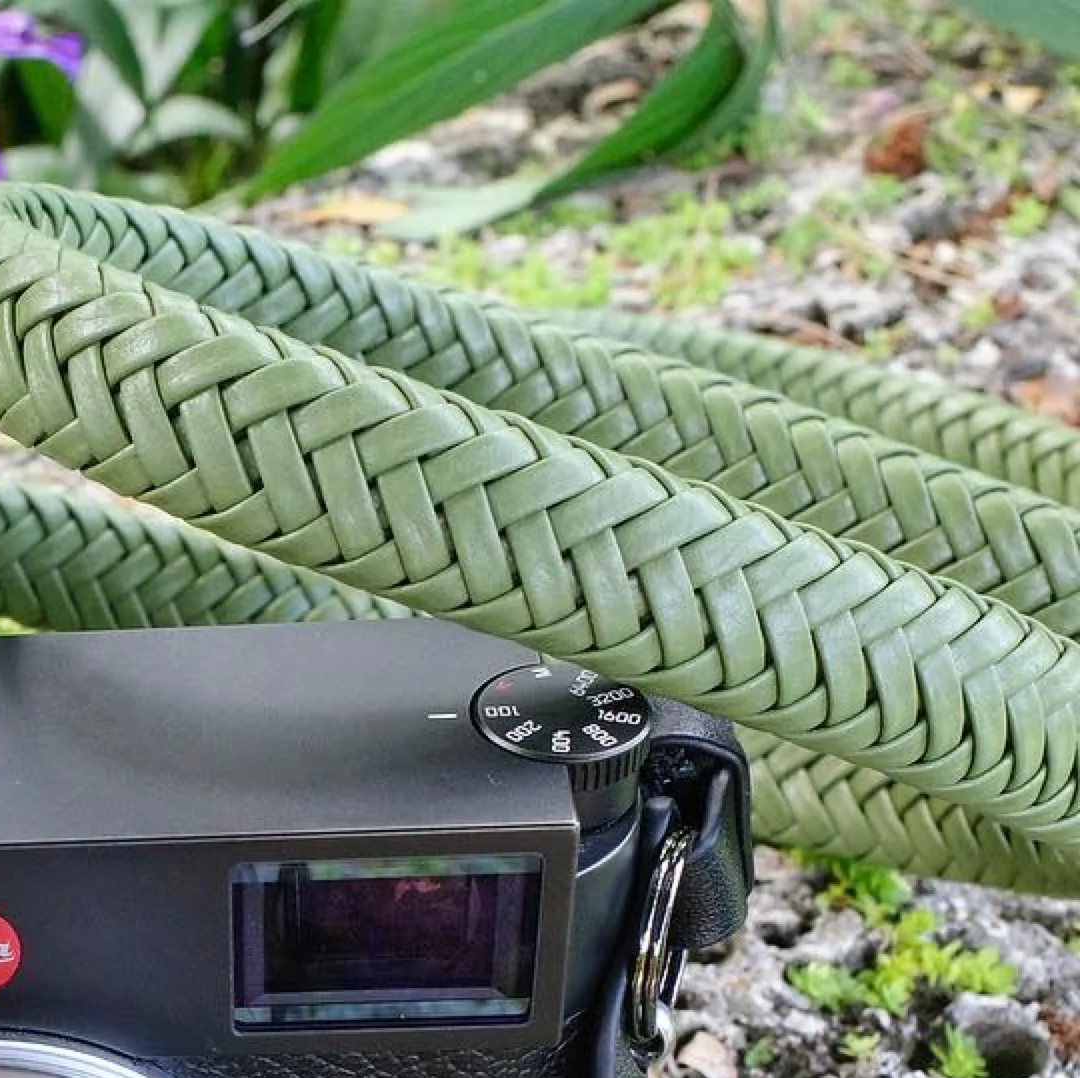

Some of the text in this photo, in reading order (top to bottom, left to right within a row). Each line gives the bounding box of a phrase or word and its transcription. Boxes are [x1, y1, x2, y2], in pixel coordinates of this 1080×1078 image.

[585, 687, 635, 707] 3200
[485, 705, 520, 718] 100
[597, 709, 642, 725] 1600
[505, 719, 543, 743] 200
[551, 729, 571, 753] 400
[581, 723, 618, 748] 800
